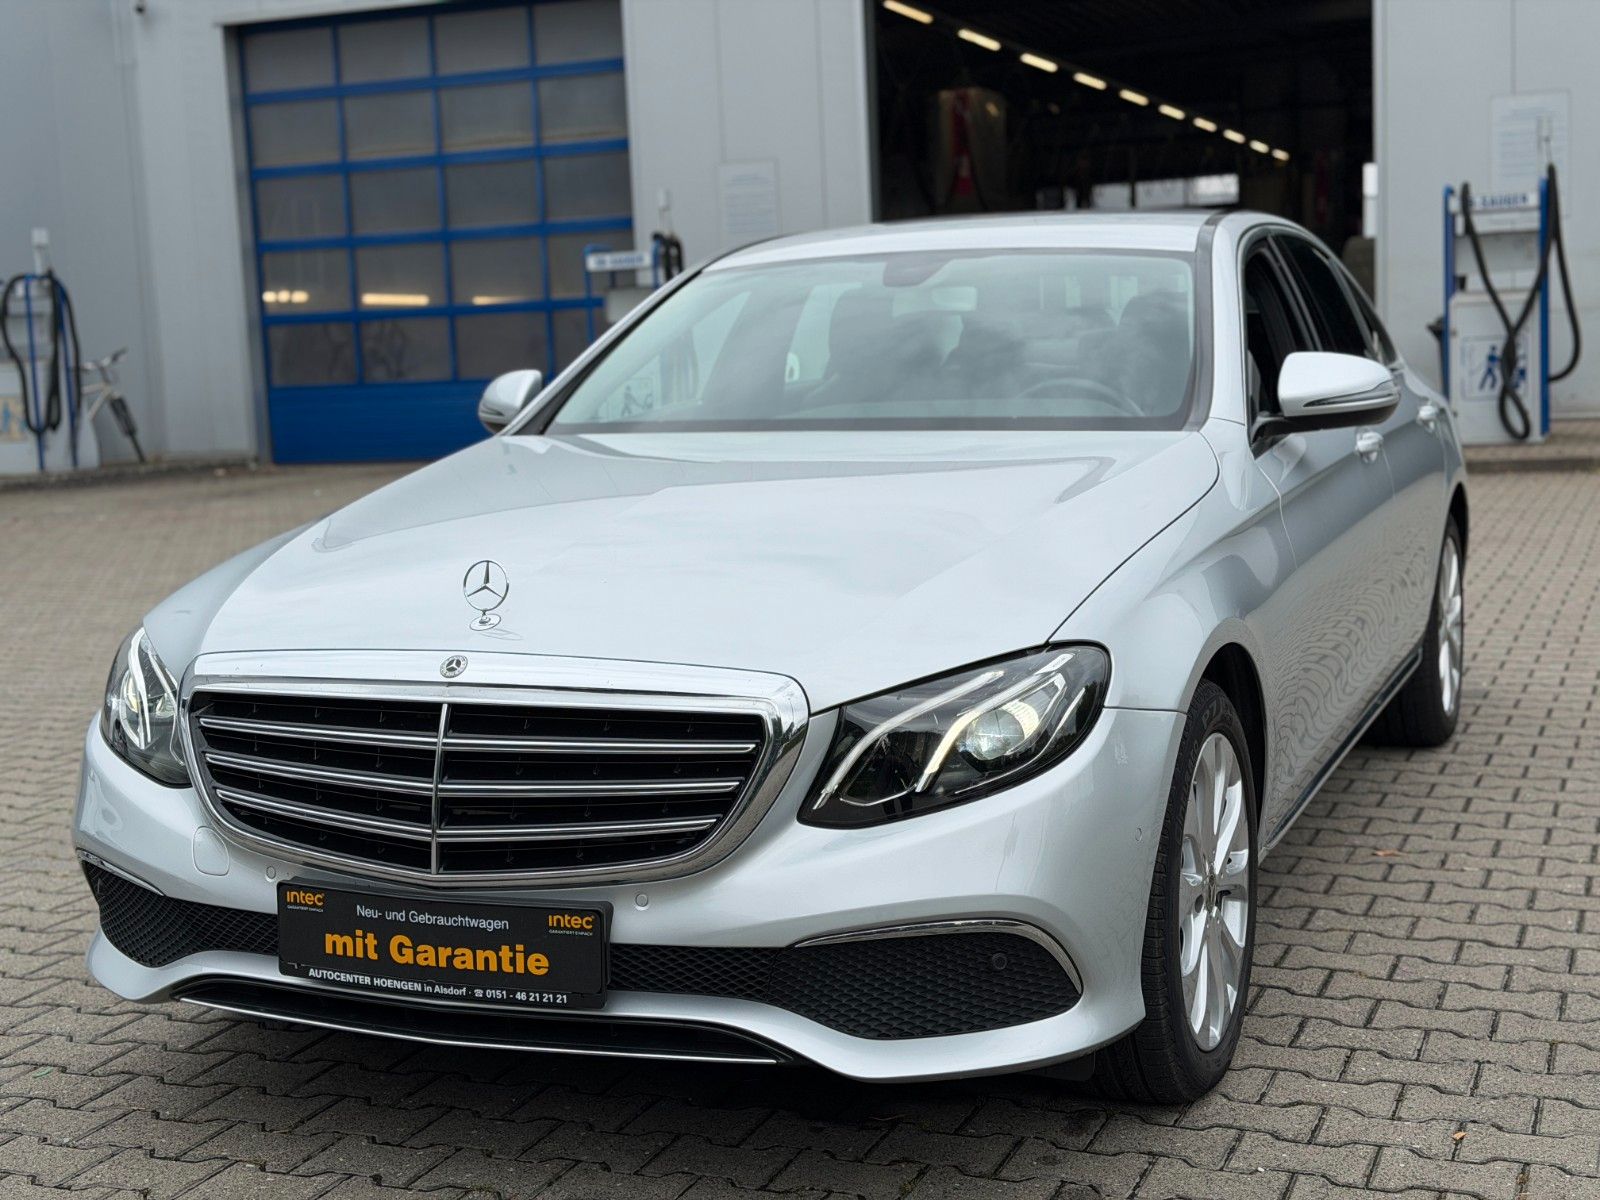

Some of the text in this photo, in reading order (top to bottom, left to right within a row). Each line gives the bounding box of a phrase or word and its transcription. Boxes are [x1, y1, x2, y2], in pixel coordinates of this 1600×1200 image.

[287, 890, 324, 906] intec
[356, 905, 509, 932] Neu- und Gebrauchtwagen
[548, 913, 593, 930] intec
[325, 929, 549, 976] mit Garantie
[308, 968, 371, 986] AUTOCENTER
[373, 977, 421, 992] HOENGEN
[424, 983, 432, 993] in
[434, 985, 466, 996] Alsdorf
[486, 989, 507, 999] 0151
[515, 991, 527, 1001] 46
[529, 992, 540, 1002] 21
[542, 993, 553, 1003] 21
[556, 994, 568, 1004] 21
